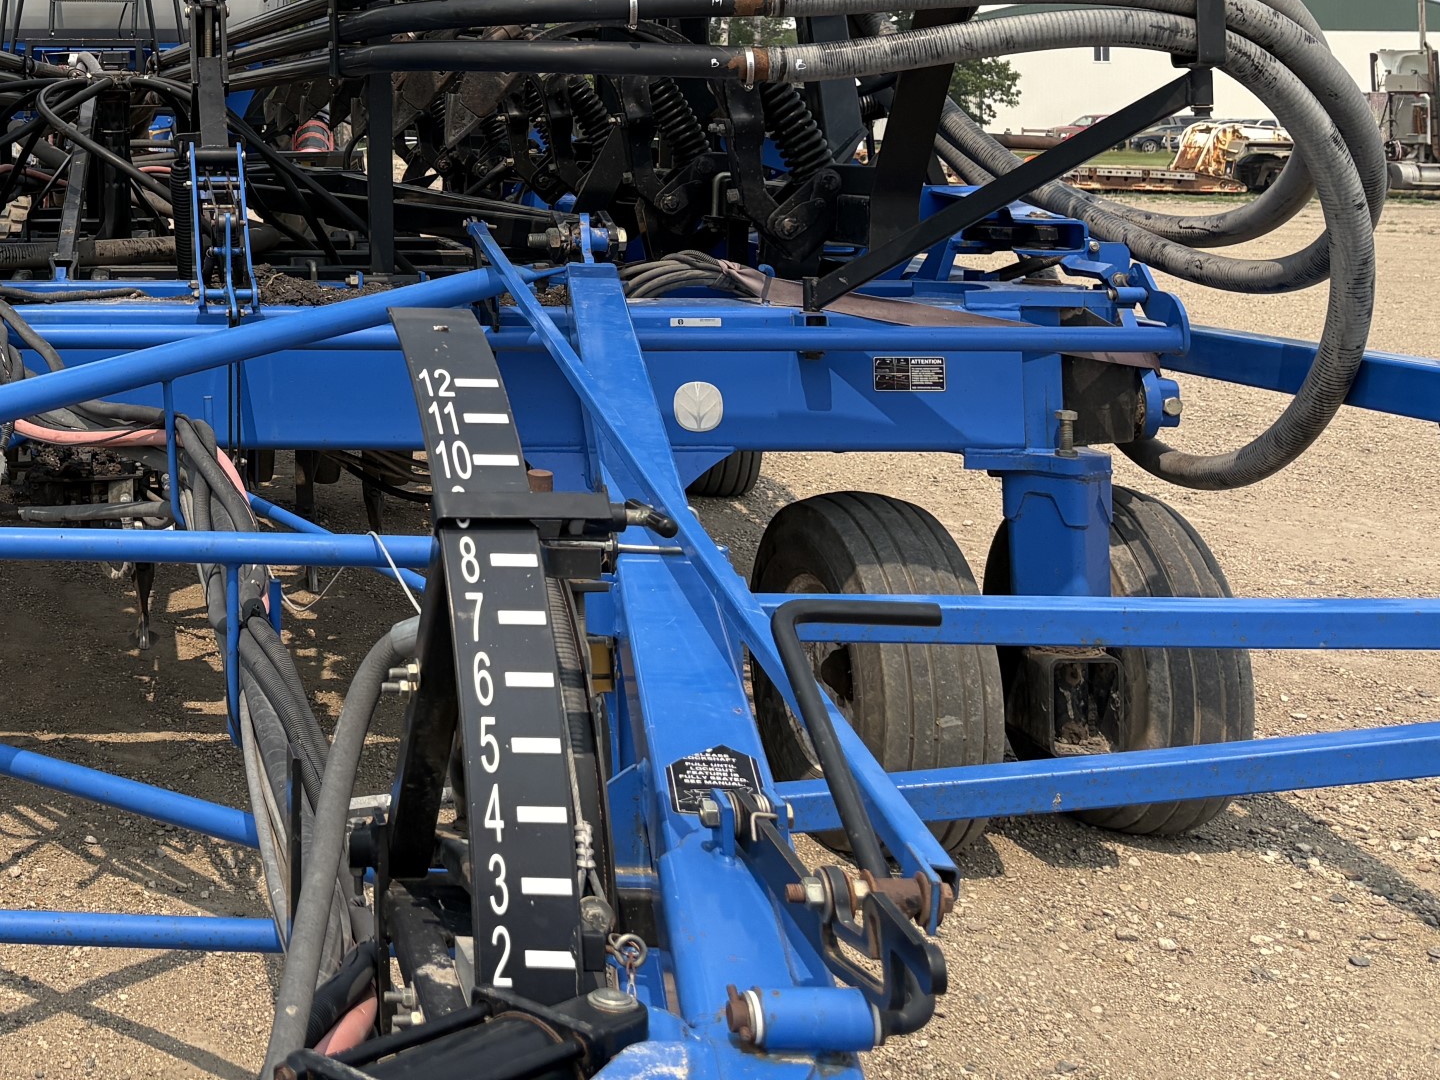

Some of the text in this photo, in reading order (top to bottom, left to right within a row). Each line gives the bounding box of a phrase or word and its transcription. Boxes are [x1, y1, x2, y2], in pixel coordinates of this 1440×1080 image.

[418, 368, 456, 398] 12
[428, 400, 460, 436] 11
[435, 439, 473, 480] 10
[459, 535, 481, 584] 8
[464, 591, 484, 643] 7
[473, 651, 494, 707] 6
[480, 716, 500, 774] 5
[484, 783, 505, 843] 4
[488, 853, 509, 916] 3
[491, 925, 513, 988] 2
